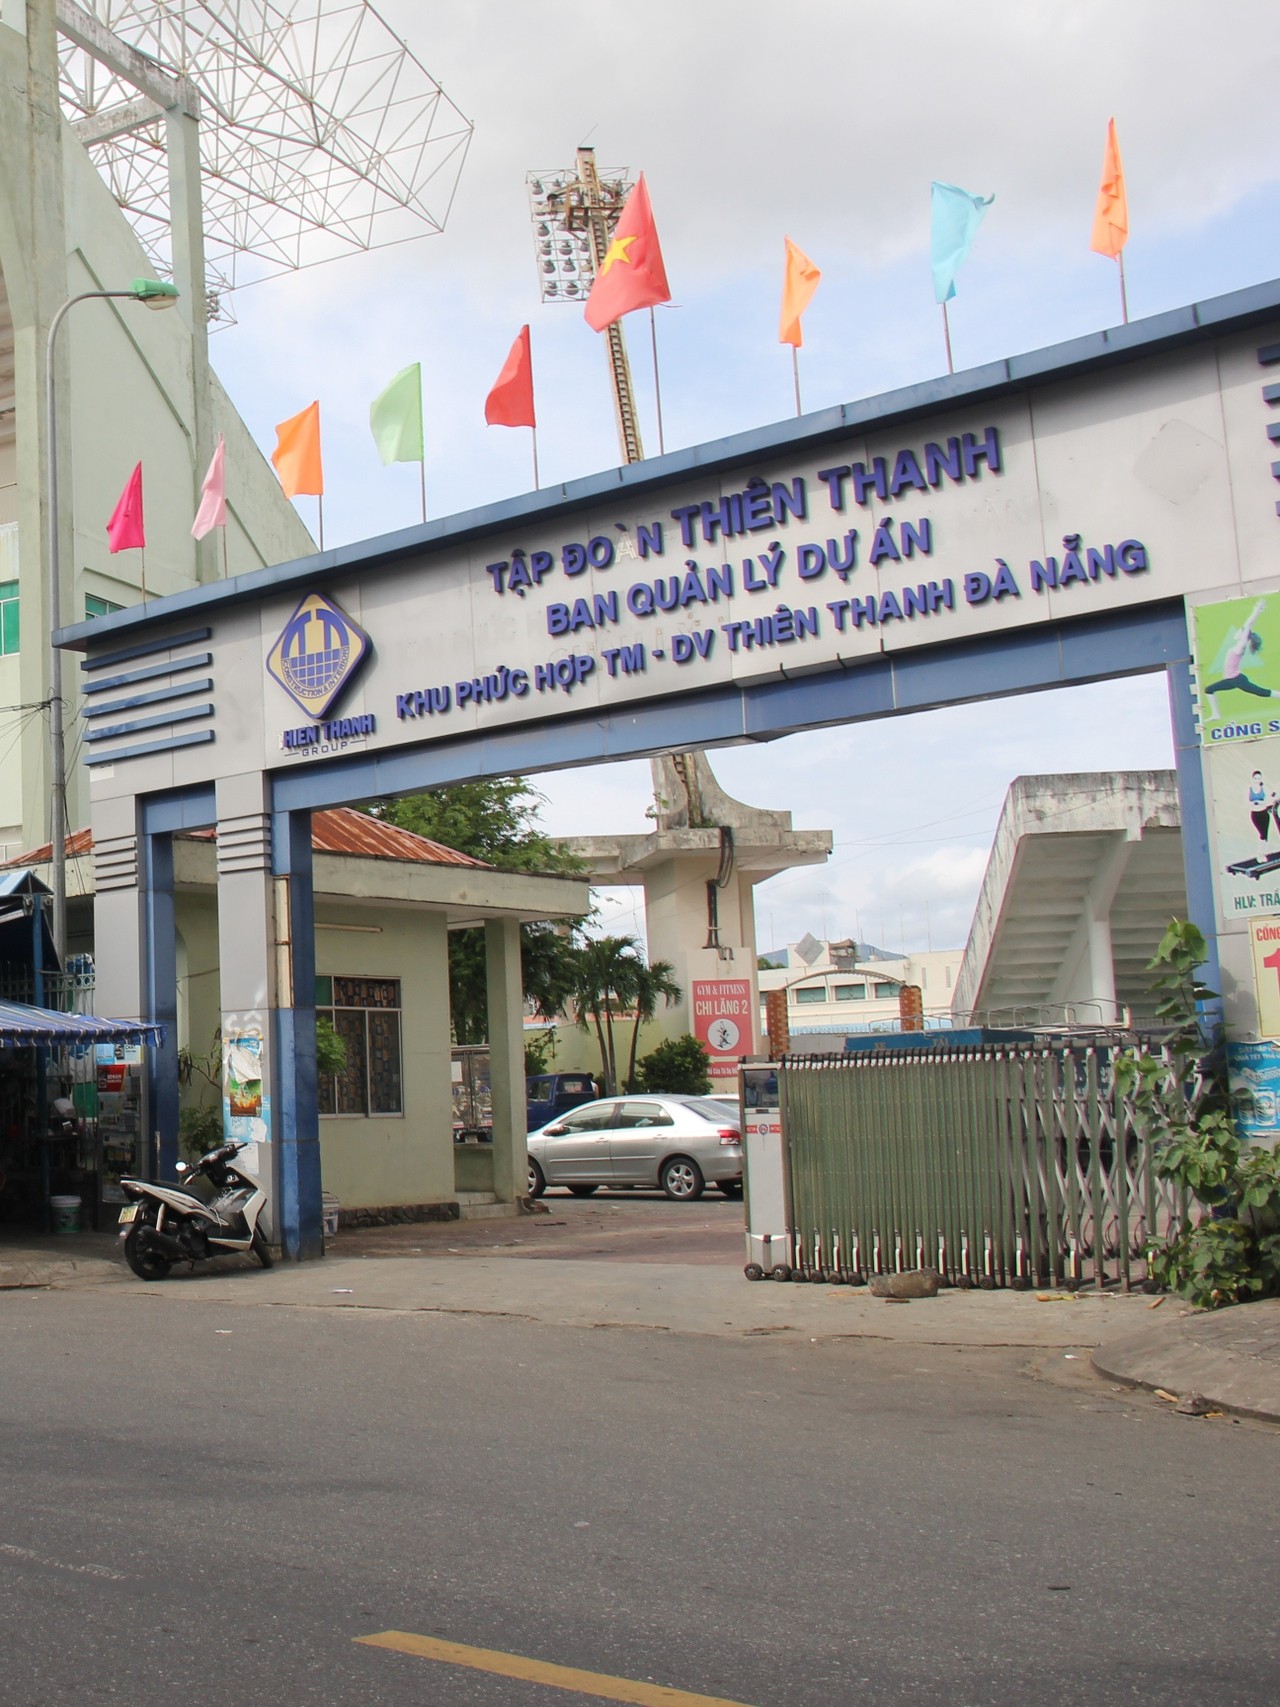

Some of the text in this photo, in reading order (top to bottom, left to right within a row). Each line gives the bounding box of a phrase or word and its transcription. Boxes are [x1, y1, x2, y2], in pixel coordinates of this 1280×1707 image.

[486, 426, 1001, 597] TẬP ĐOÀN THIÊN THANH
[546, 516, 932, 636] BAN QUẢN LÝ DỰ ÁN
[396, 685, 450, 719] KHU
[455, 665, 529, 707] PHỨC
[534, 654, 595, 693] HỢP
[601, 643, 645, 676] TM
[671, 628, 714, 663] DV
[722, 604, 819, 651] THIÊN
[826, 578, 953, 631] THANH
[962, 558, 1020, 604] ĐÀ
[1030, 532, 1148, 591] NẴNG
[320, 714, 376, 741] THANH
[301, 741, 348, 757] GROUP
[1233, 894, 1256, 911] HLV:
[696, 984, 711, 996] GYM
[720, 984, 745, 995] FITNESS
[696, 998, 748, 1015] CHI LĂNG 2
